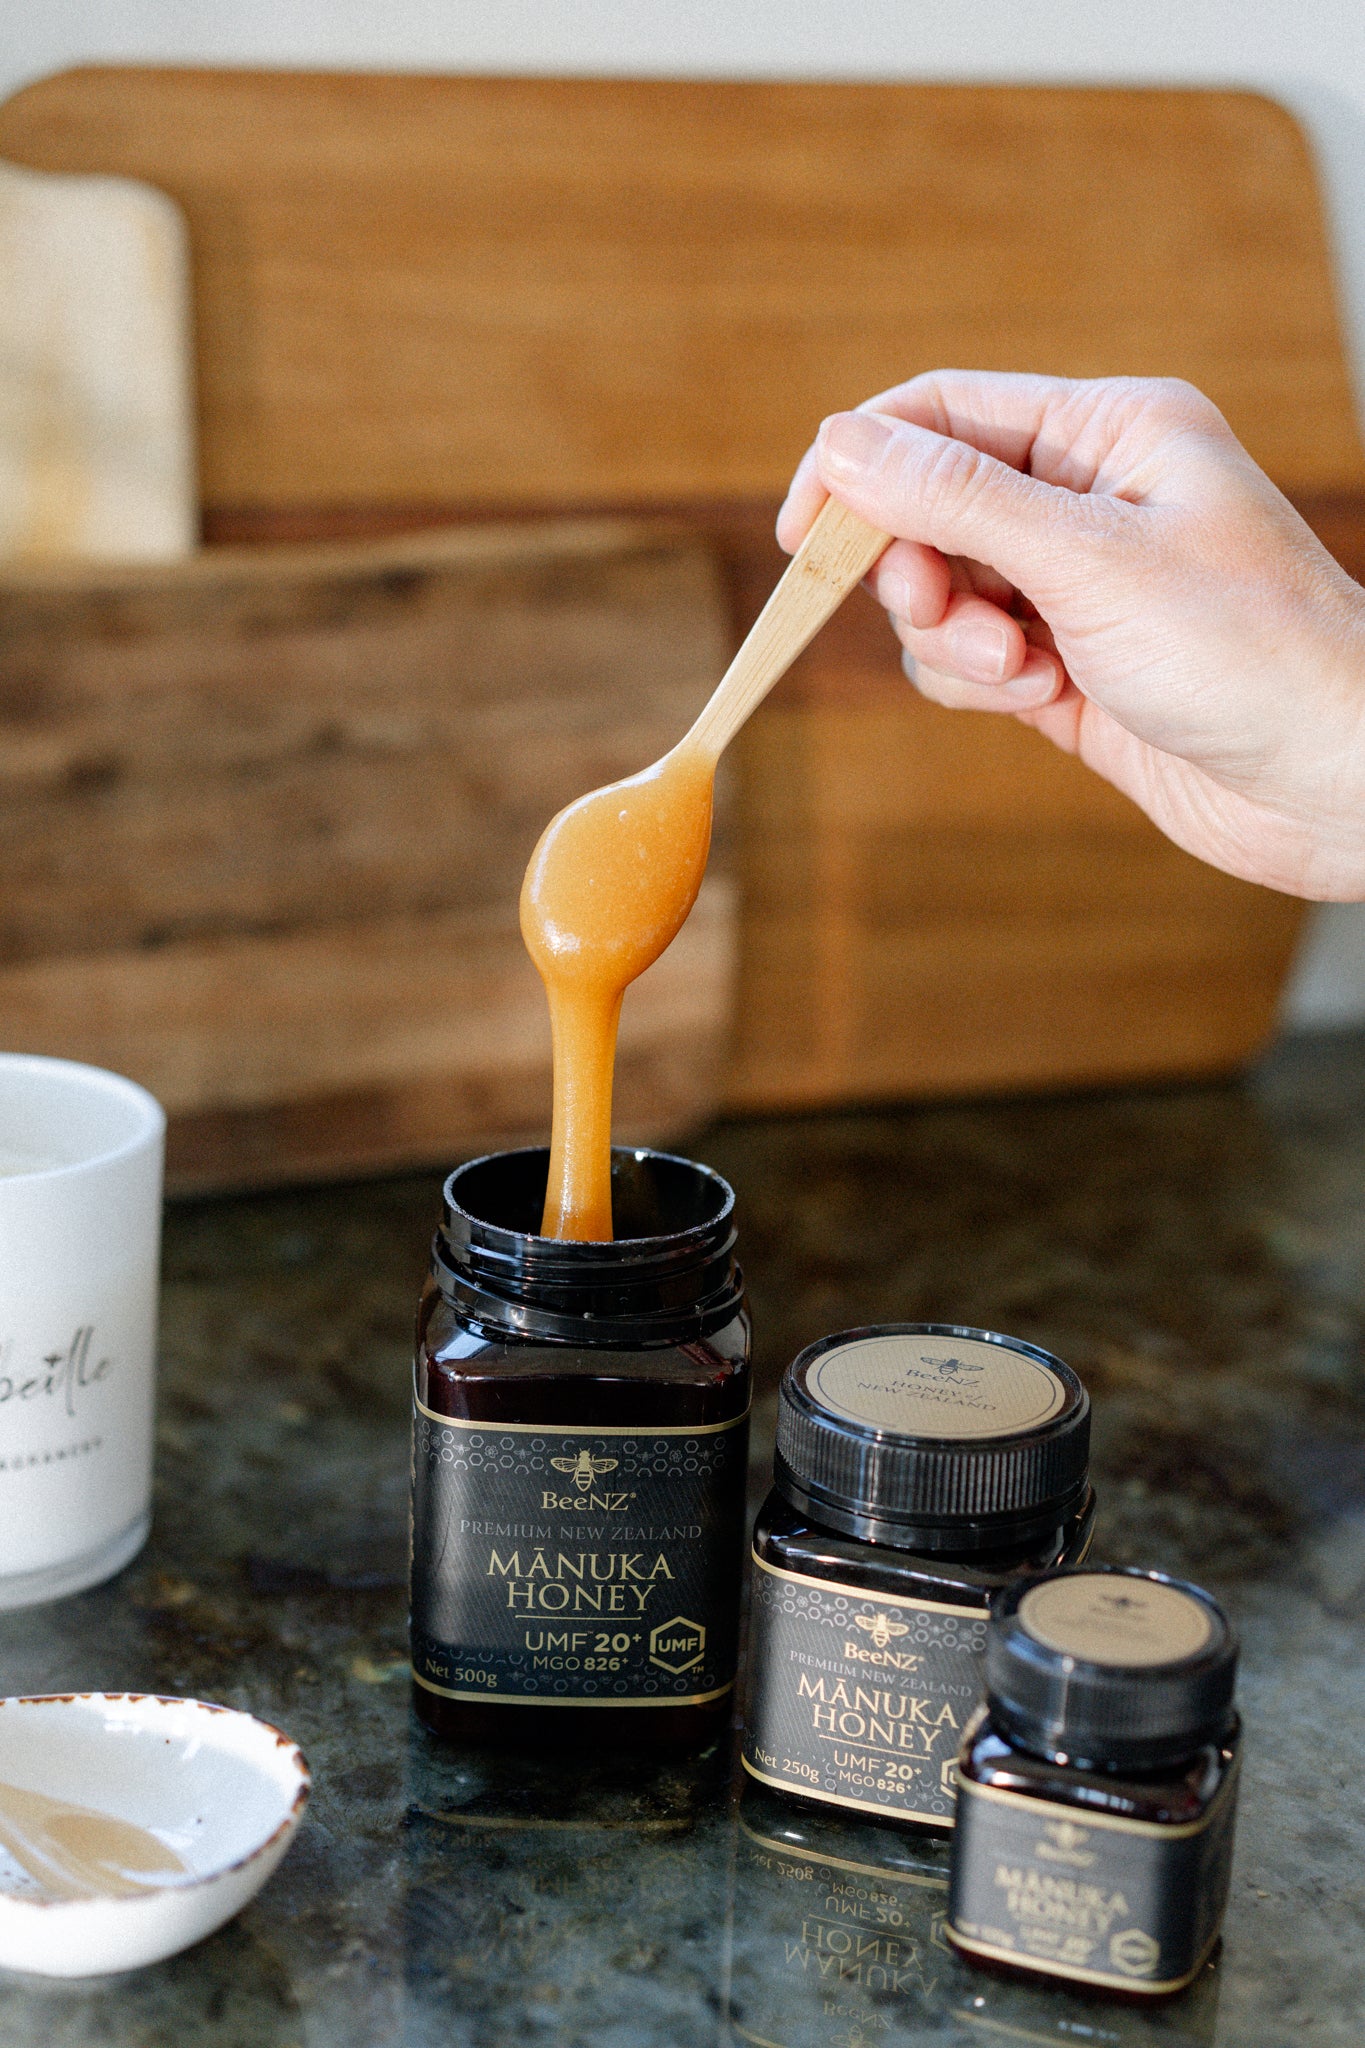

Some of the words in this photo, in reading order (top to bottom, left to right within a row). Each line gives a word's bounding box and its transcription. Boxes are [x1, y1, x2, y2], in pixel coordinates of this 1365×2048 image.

[906, 1369, 980, 1387] BeeNZ
[857, 1382, 901, 1394] NEW
[906, 1392, 997, 1411] ZEALAND
[460, 1519, 551, 1540] PREMIUM
[560, 1525, 605, 1540] NEW
[611, 1525, 702, 1540] ZEALAND
[486, 1547, 676, 1580] MĀNUKA
[506, 1581, 657, 1612] HONEY
[658, 1637, 698, 1652] UMF
[425, 1658, 450, 1680] Net
[454, 1667, 497, 1688] 500g
[533, 1656, 581, 1671] MGO
[790, 1650, 857, 1677] PREMIUM
[861, 1668, 896, 1685] NEW
[900, 1676, 972, 1698] ZEALAND
[796, 1673, 960, 1729] MĀNUKA
[812, 1704, 942, 1752] HONEY
[755, 1747, 777, 1769] Net
[782, 1759, 820, 1783] 250g
[839, 1769, 876, 1788] MGO
